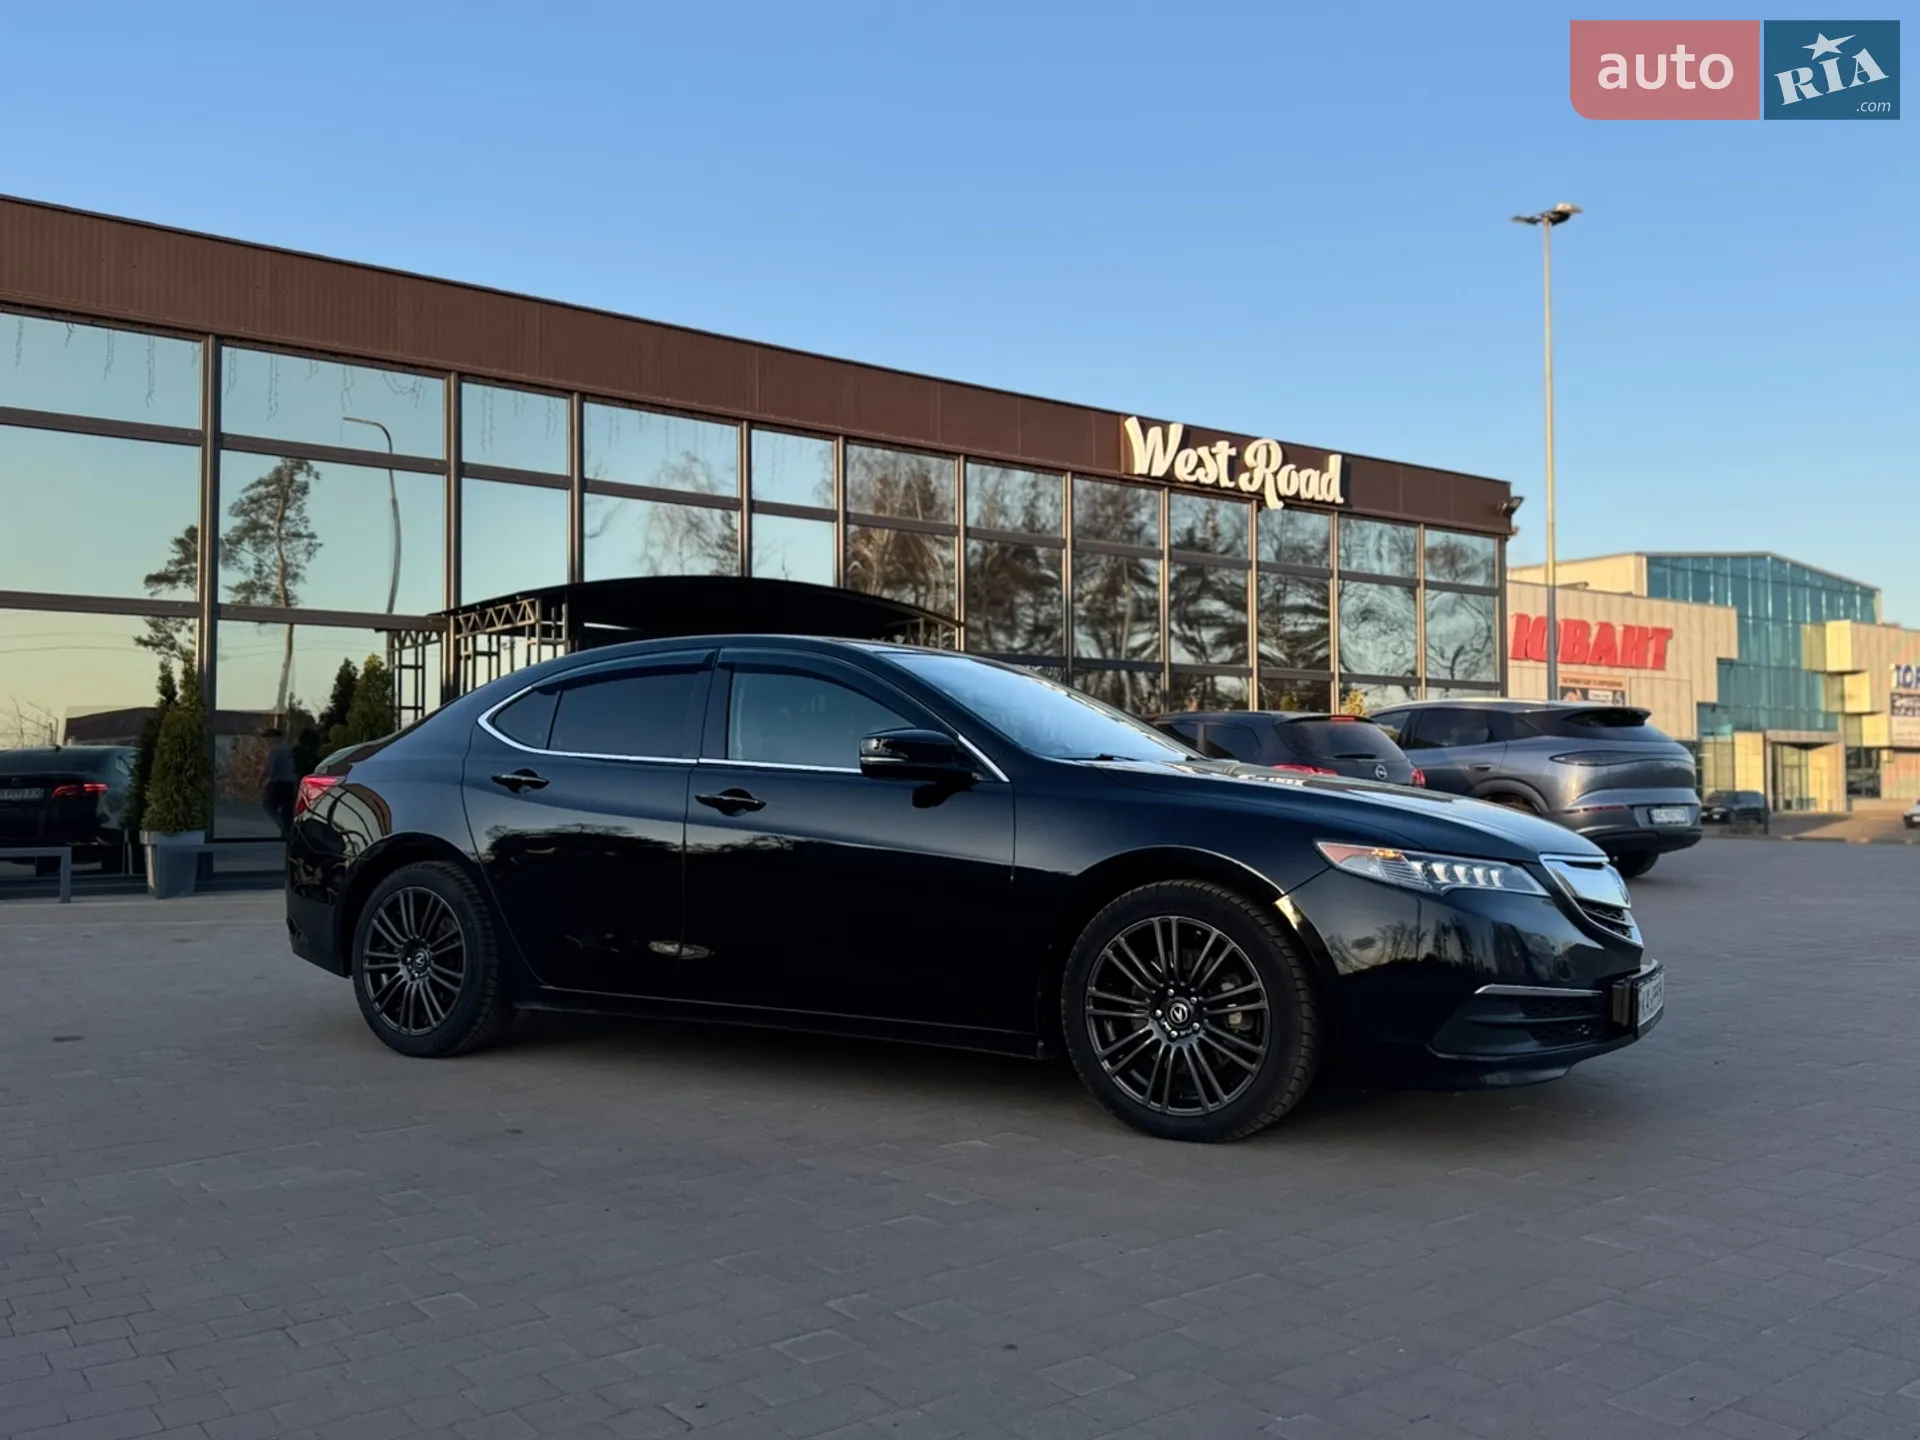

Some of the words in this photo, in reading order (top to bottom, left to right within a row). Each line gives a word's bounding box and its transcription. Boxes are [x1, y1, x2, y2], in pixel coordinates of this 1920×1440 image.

[1124, 416, 1236, 487] West
[1239, 438, 1344, 510] Road
[1511, 613, 1673, 671] ЮВАНТ
